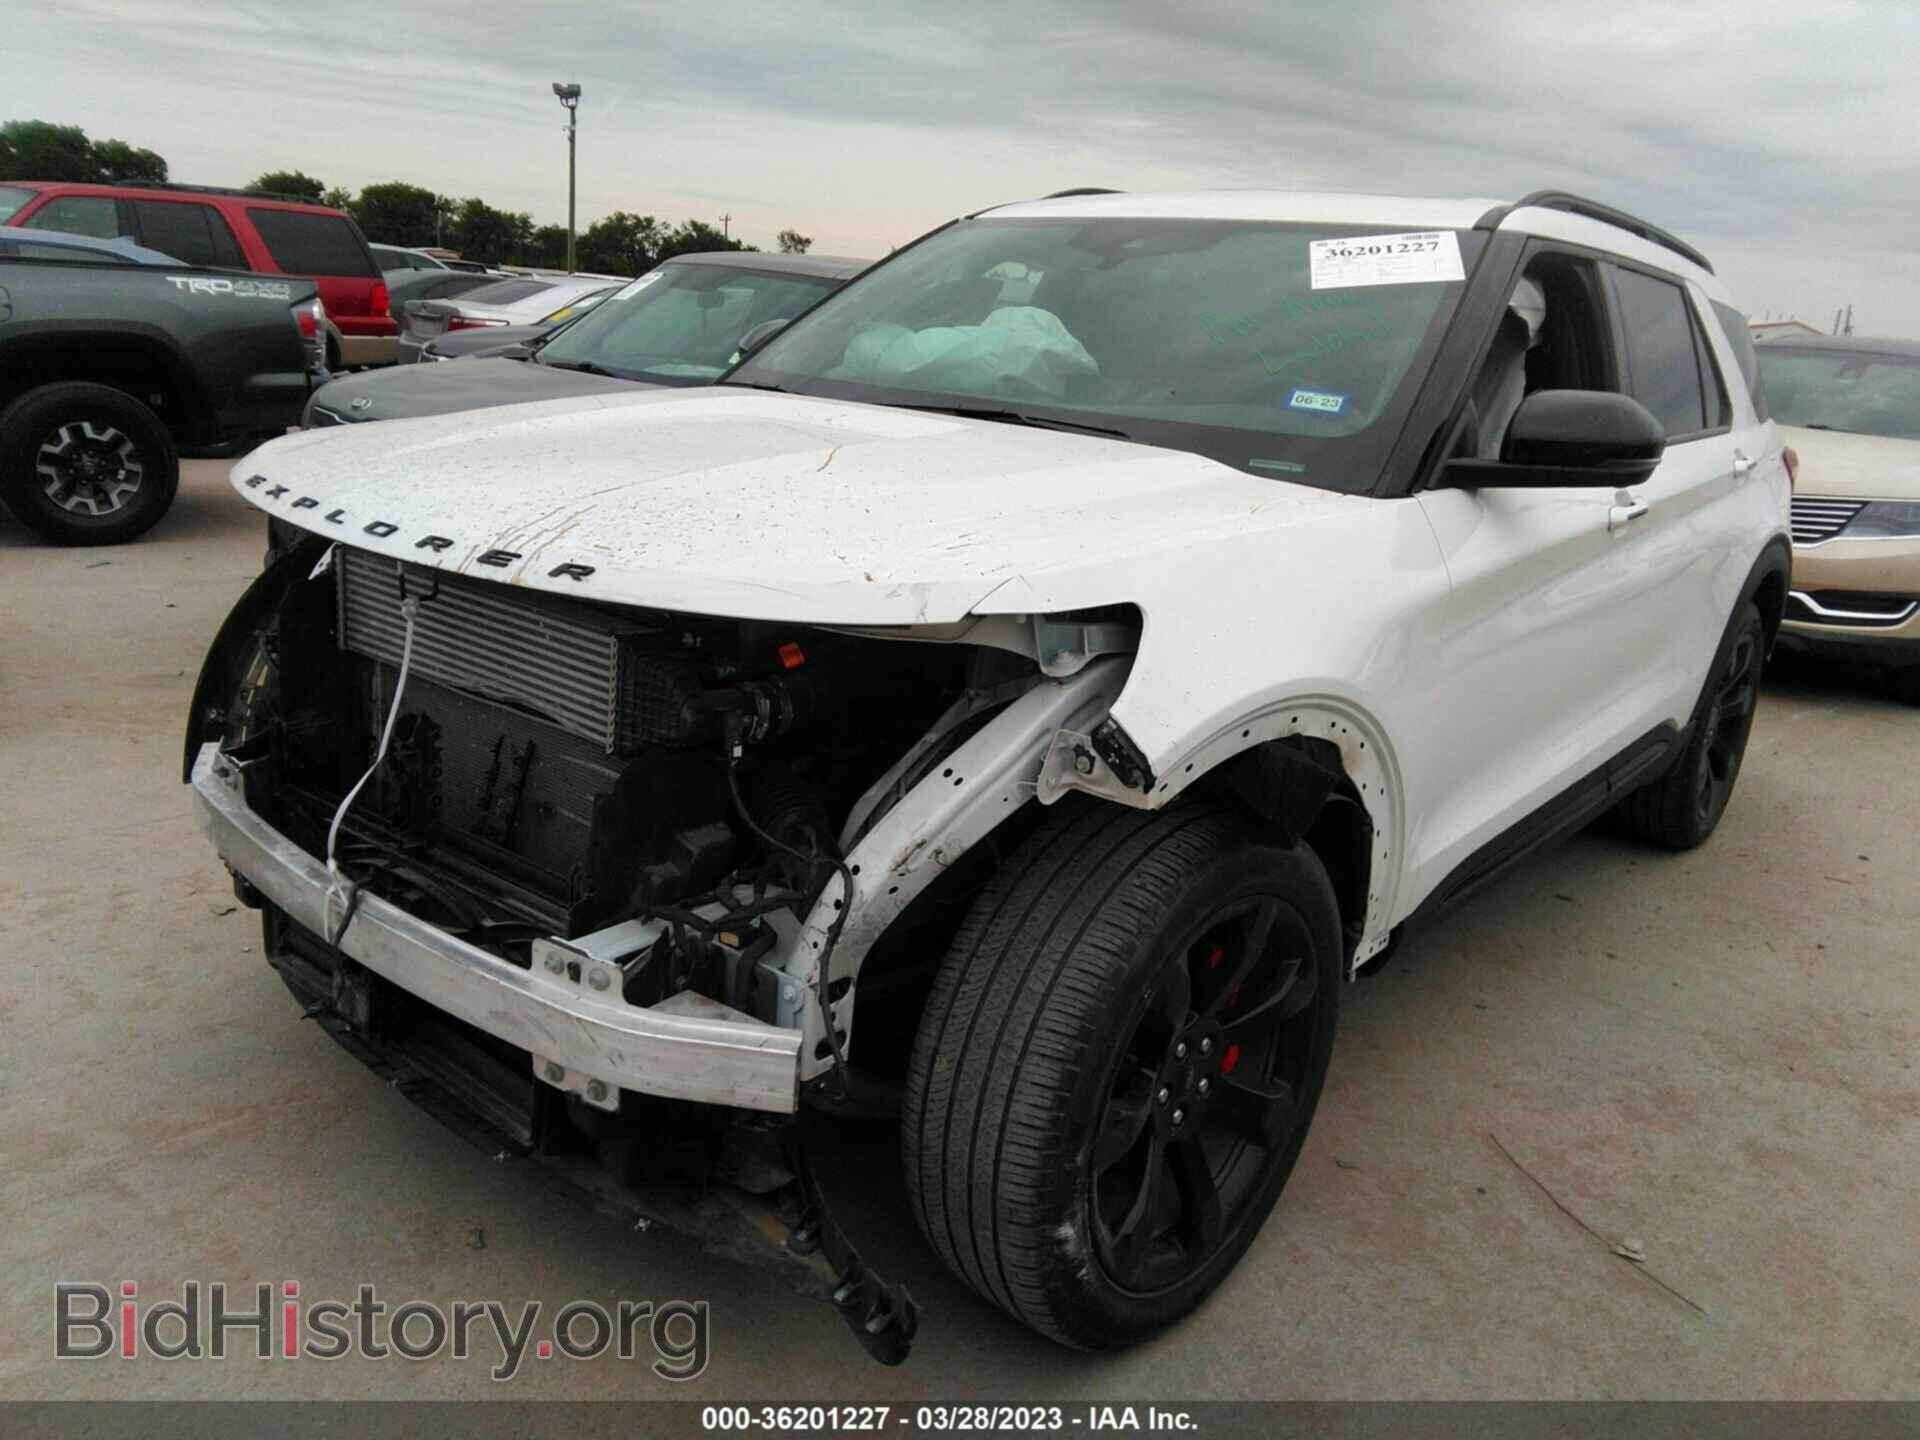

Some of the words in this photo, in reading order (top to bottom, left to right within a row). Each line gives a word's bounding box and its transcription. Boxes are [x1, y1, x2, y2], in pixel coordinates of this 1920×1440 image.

[1326, 241, 1440, 258] 36201227
[165, 276, 232, 294] TRD
[245, 474, 596, 582] EXPLORER
